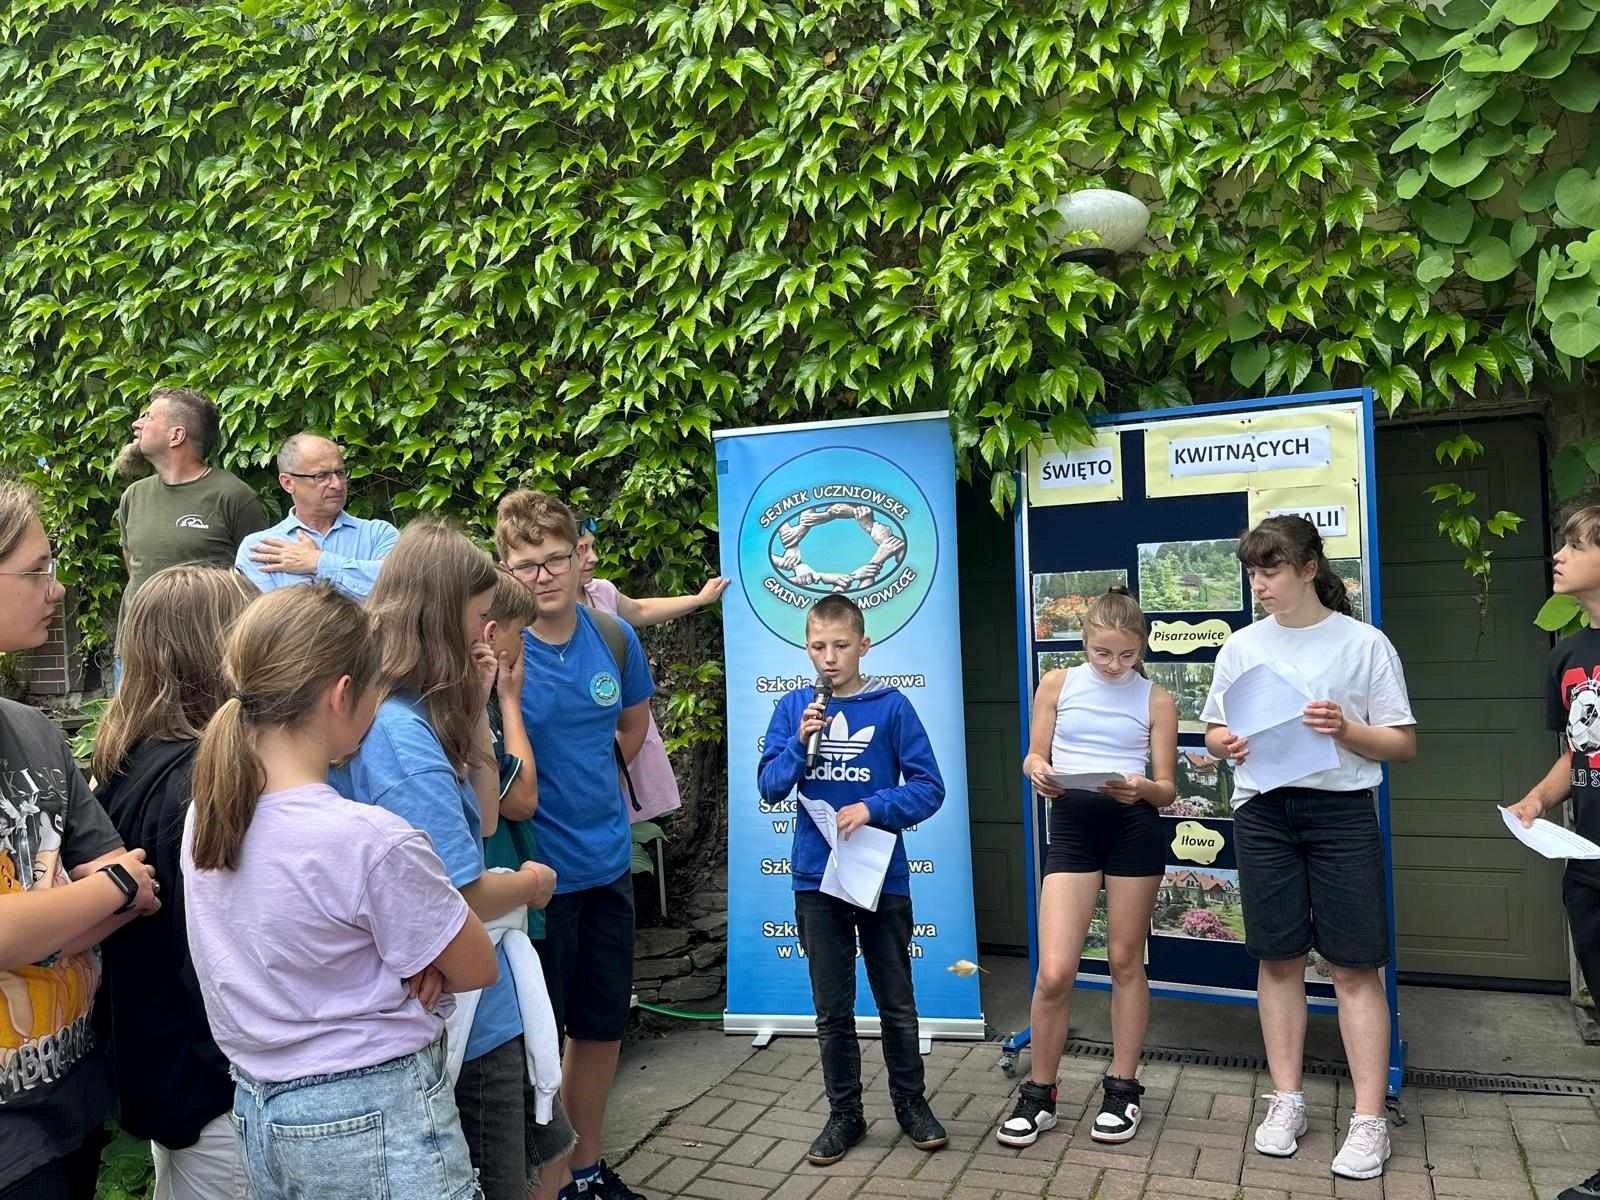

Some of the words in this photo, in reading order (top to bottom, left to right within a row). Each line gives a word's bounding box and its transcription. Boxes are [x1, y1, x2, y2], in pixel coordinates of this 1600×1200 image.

[1174, 437, 1310, 465] KWITNĄCYCH
[1042, 459, 1112, 480] ŚWIĘTO
[759, 490, 809, 529] SEJMIK
[813, 484, 909, 520] UCZNIOWSKI
[763, 576, 810, 609] GMINY
[1153, 629, 1225, 641] Pisarzowice
[773, 820, 788, 834] w
[1181, 834, 1216, 847] Iłowa
[776, 945, 793, 959] w
